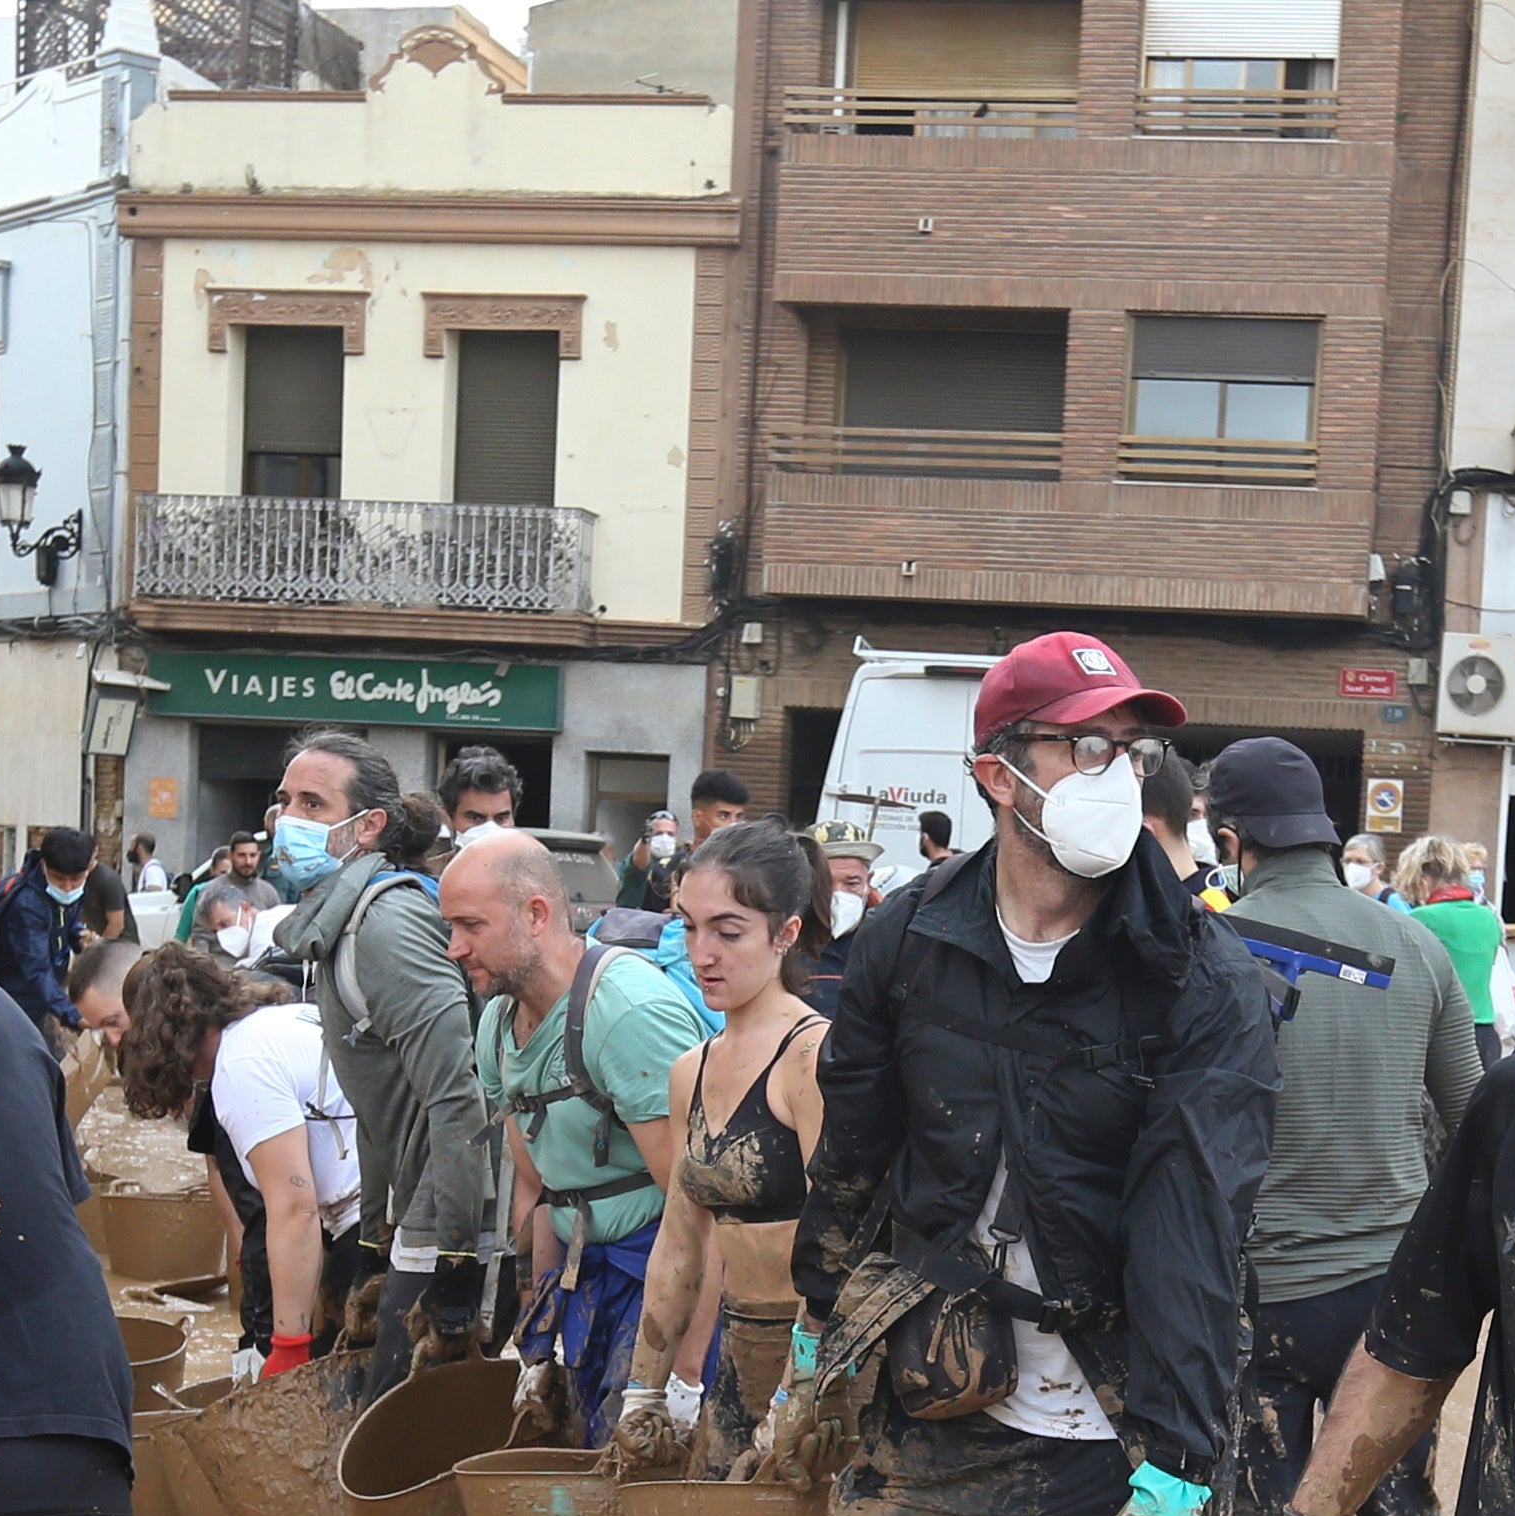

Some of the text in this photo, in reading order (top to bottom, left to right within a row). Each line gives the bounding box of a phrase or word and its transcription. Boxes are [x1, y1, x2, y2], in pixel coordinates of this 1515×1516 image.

[204, 668, 502, 714] VIAJES El Corte Inglés
